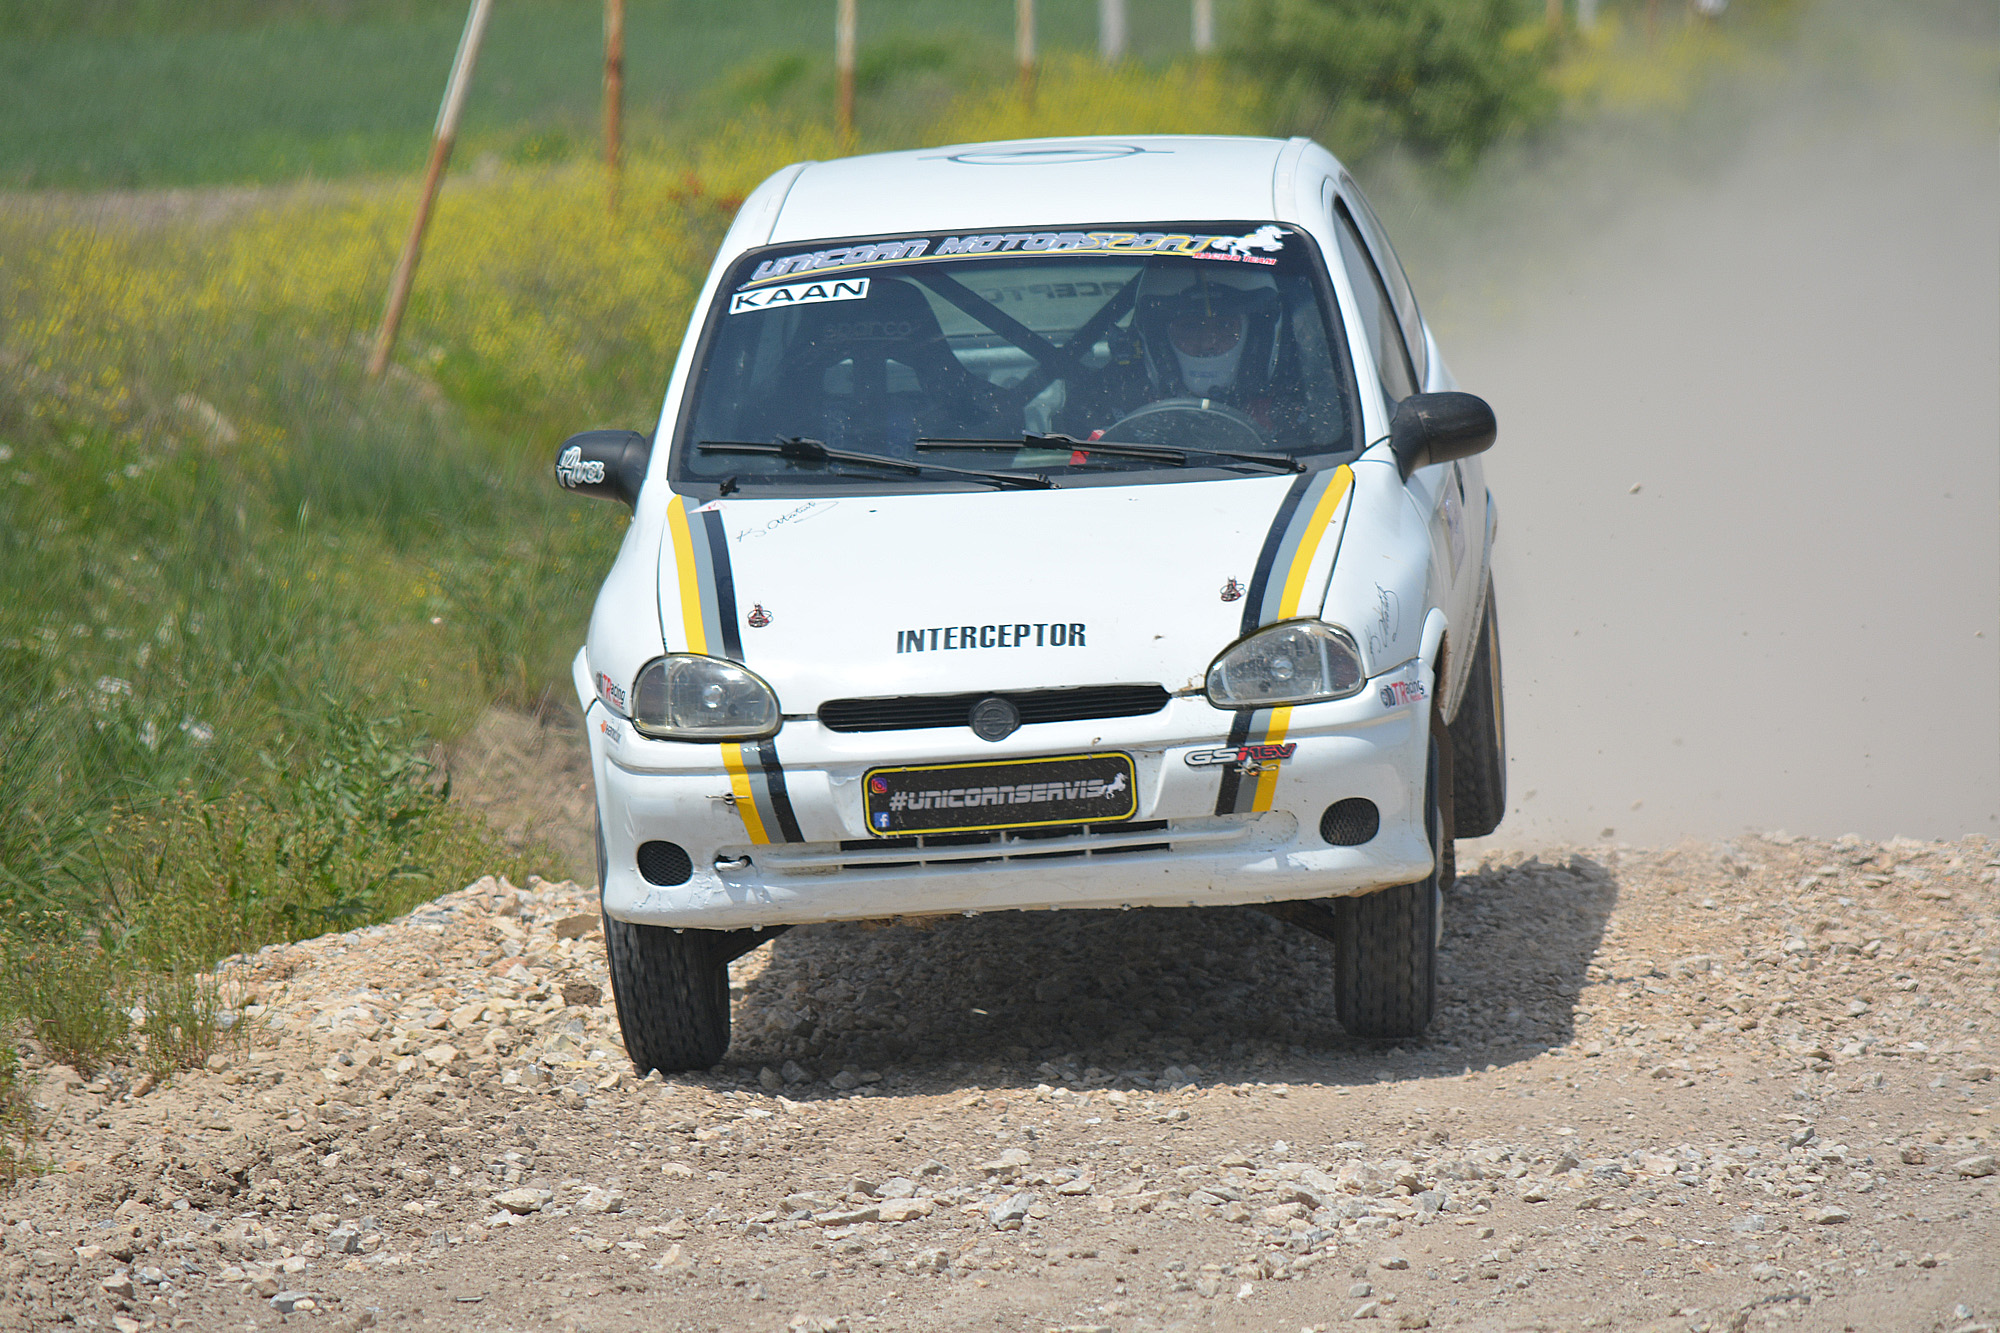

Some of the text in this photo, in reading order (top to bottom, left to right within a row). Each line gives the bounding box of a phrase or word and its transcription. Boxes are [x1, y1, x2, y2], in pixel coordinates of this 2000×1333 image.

[751, 232, 1220, 281] UNICORN MOTORSPORT
[1191, 252, 1277, 265] RACING TEAM
[735, 281, 864, 310] KAAN
[896, 623, 1087, 654] INTERCEPTOR
